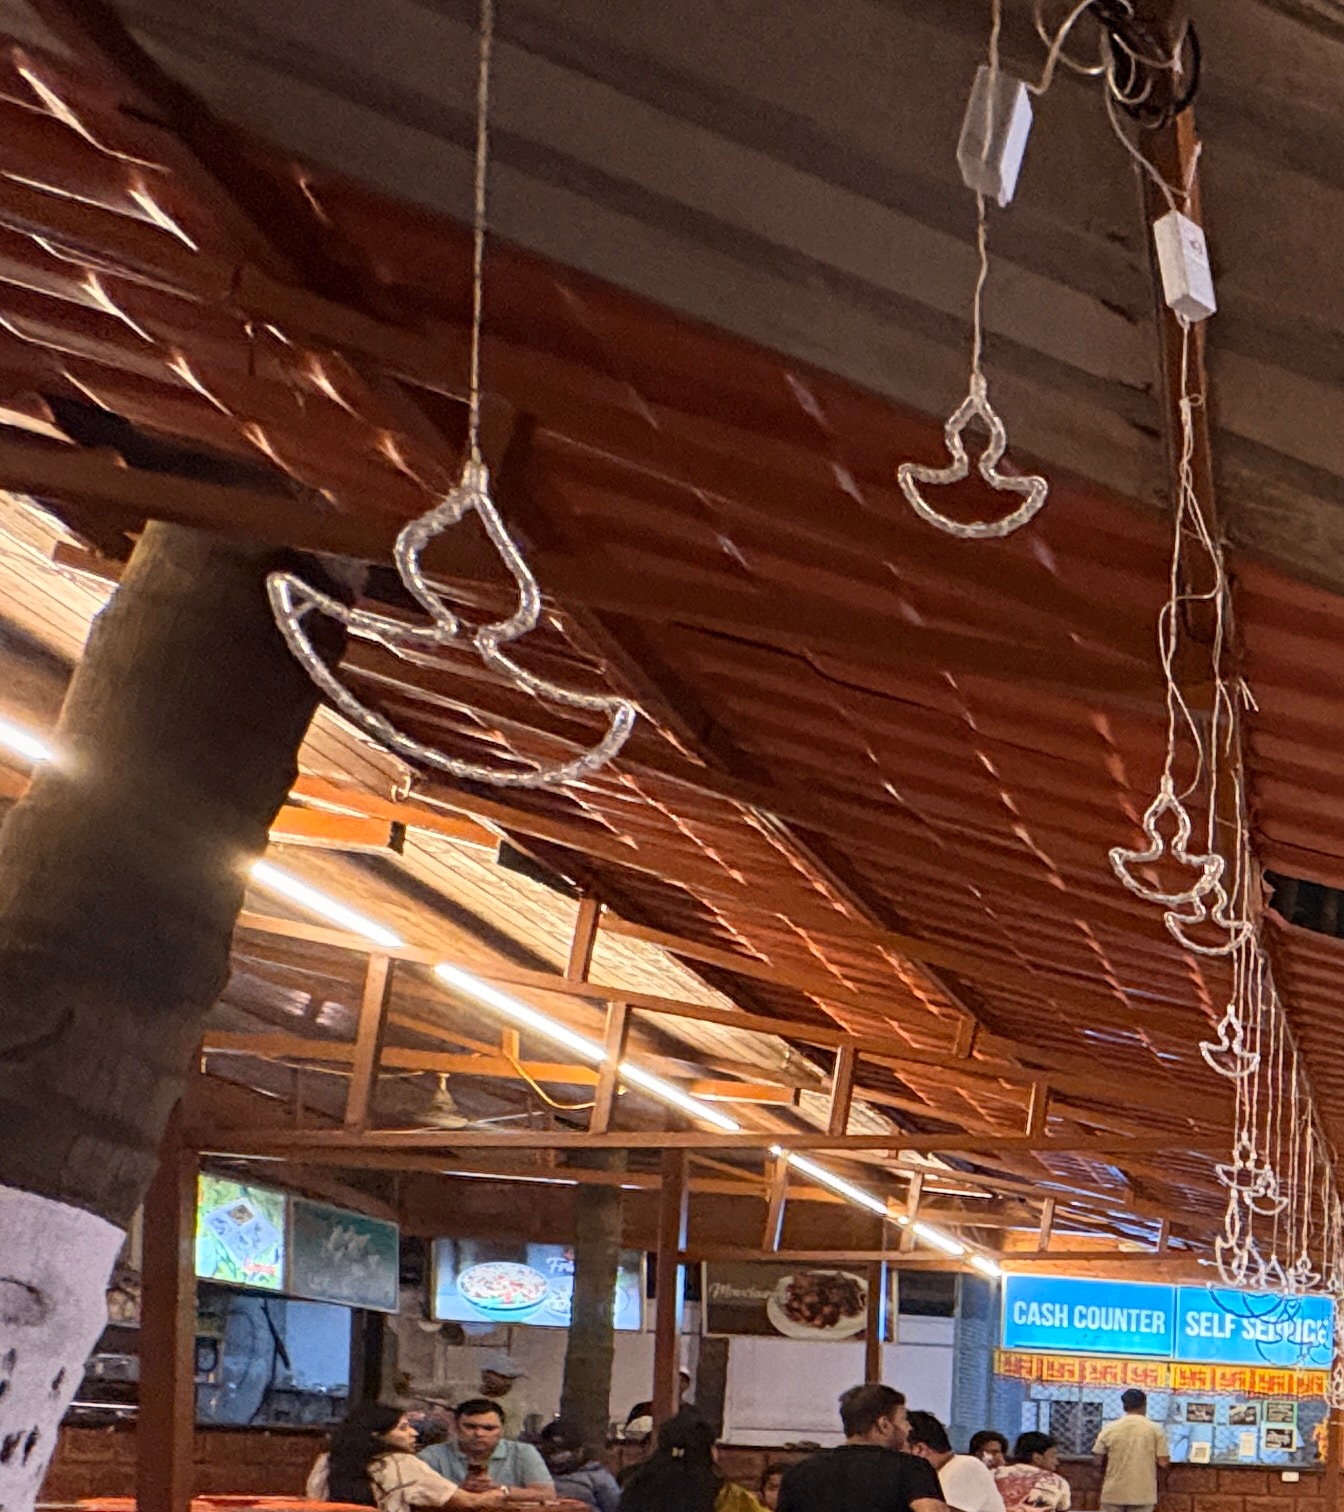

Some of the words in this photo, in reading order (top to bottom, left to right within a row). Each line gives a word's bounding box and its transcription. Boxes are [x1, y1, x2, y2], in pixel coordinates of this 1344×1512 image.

[1012, 1300, 1069, 1329] CASH
[1073, 1304, 1167, 1335] COUNTER
[1184, 1310, 1237, 1339] SELF
